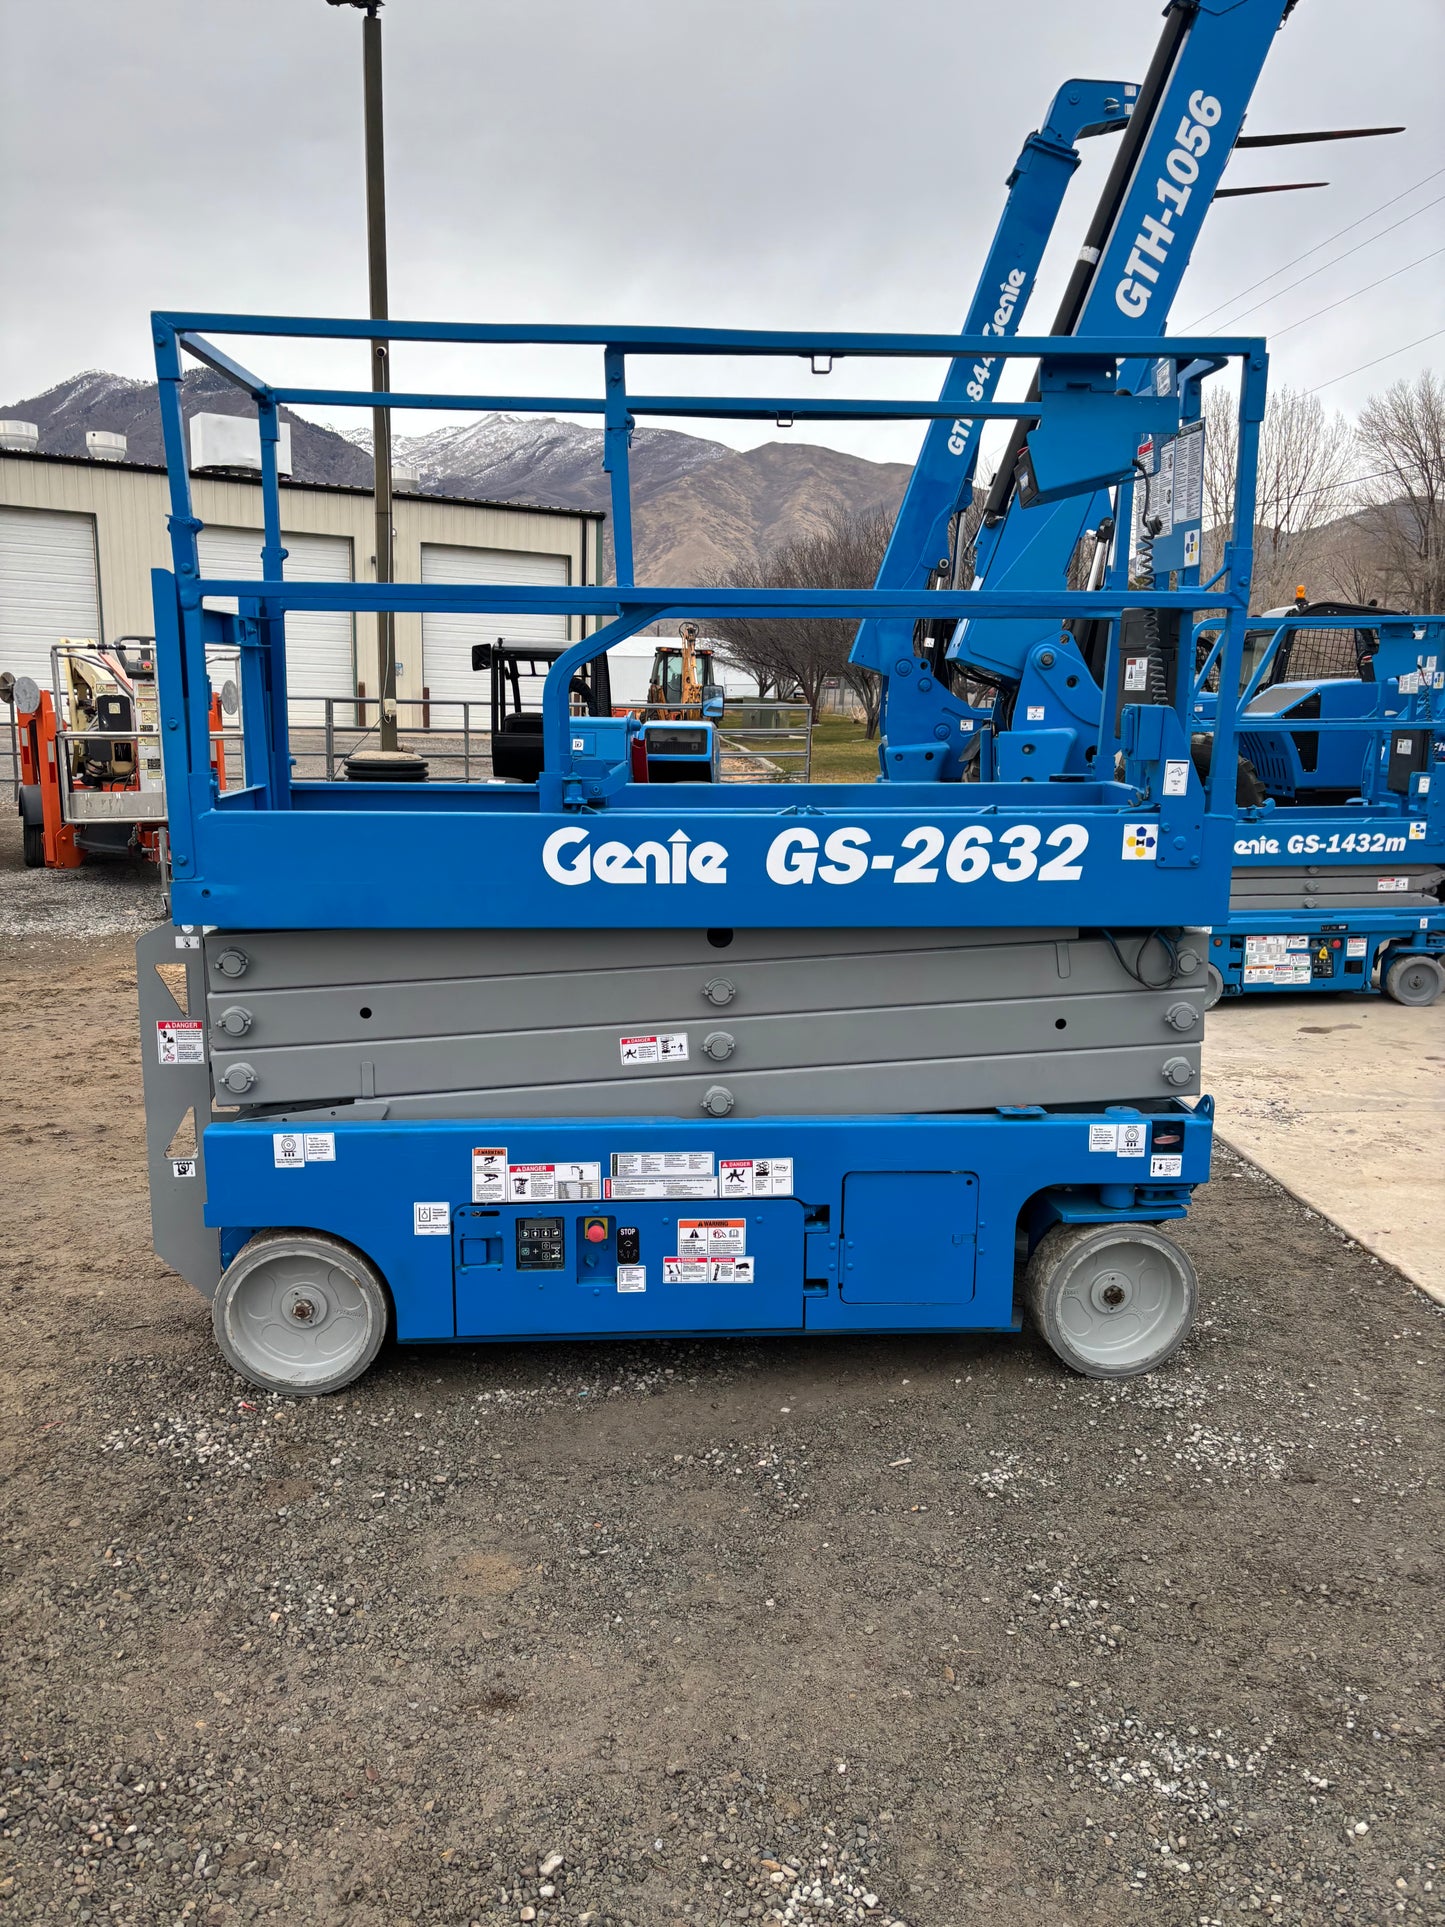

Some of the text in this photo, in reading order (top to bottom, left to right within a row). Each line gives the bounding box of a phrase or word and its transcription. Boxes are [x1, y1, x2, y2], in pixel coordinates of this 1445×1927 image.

[1115, 90, 1222, 319] GTH-1056
[542, 823, 1090, 885] Genie GS-2632
[1233, 833, 1407, 854] enie GS-1432m
[620, 1228, 636, 1236] STOP
